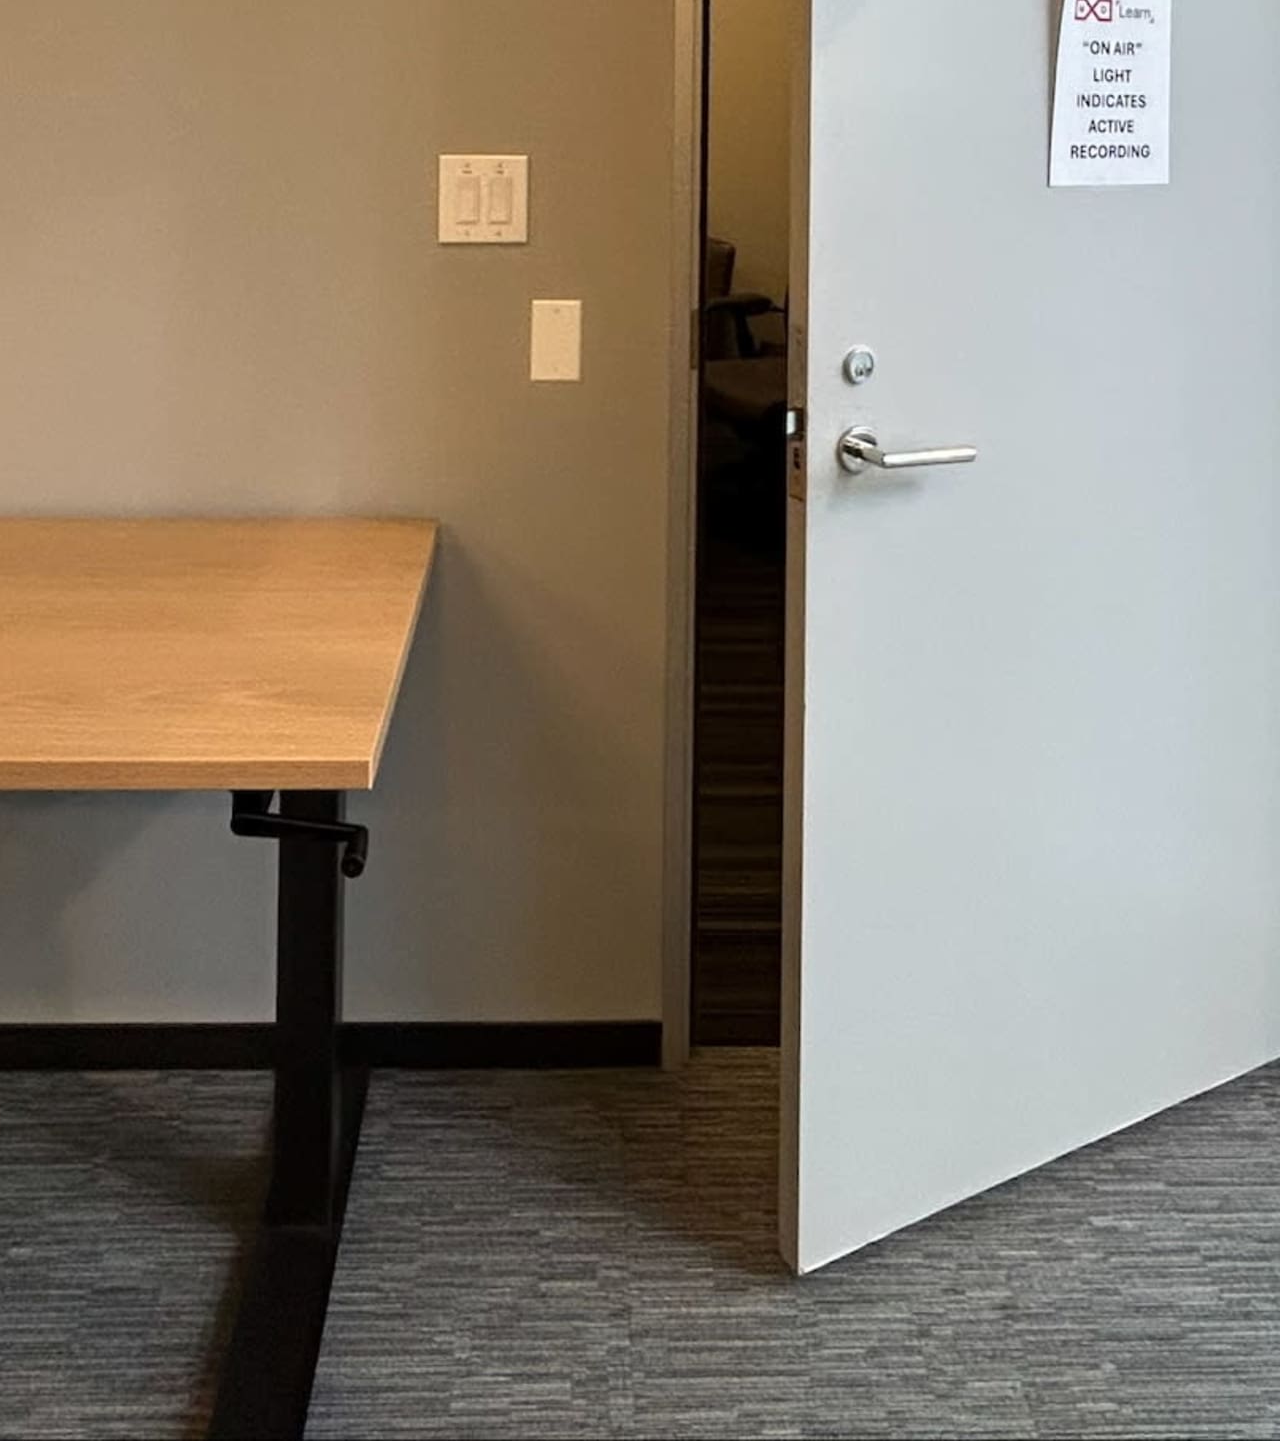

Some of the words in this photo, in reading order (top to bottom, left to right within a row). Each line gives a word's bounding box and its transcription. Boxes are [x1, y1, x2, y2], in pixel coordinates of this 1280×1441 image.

[1093, 68, 1132, 83] LIGHT
[1076, 94, 1147, 109] INDICATES
[1088, 119, 1135, 133] ACTIVE
[1070, 145, 1151, 159] RECORDING
